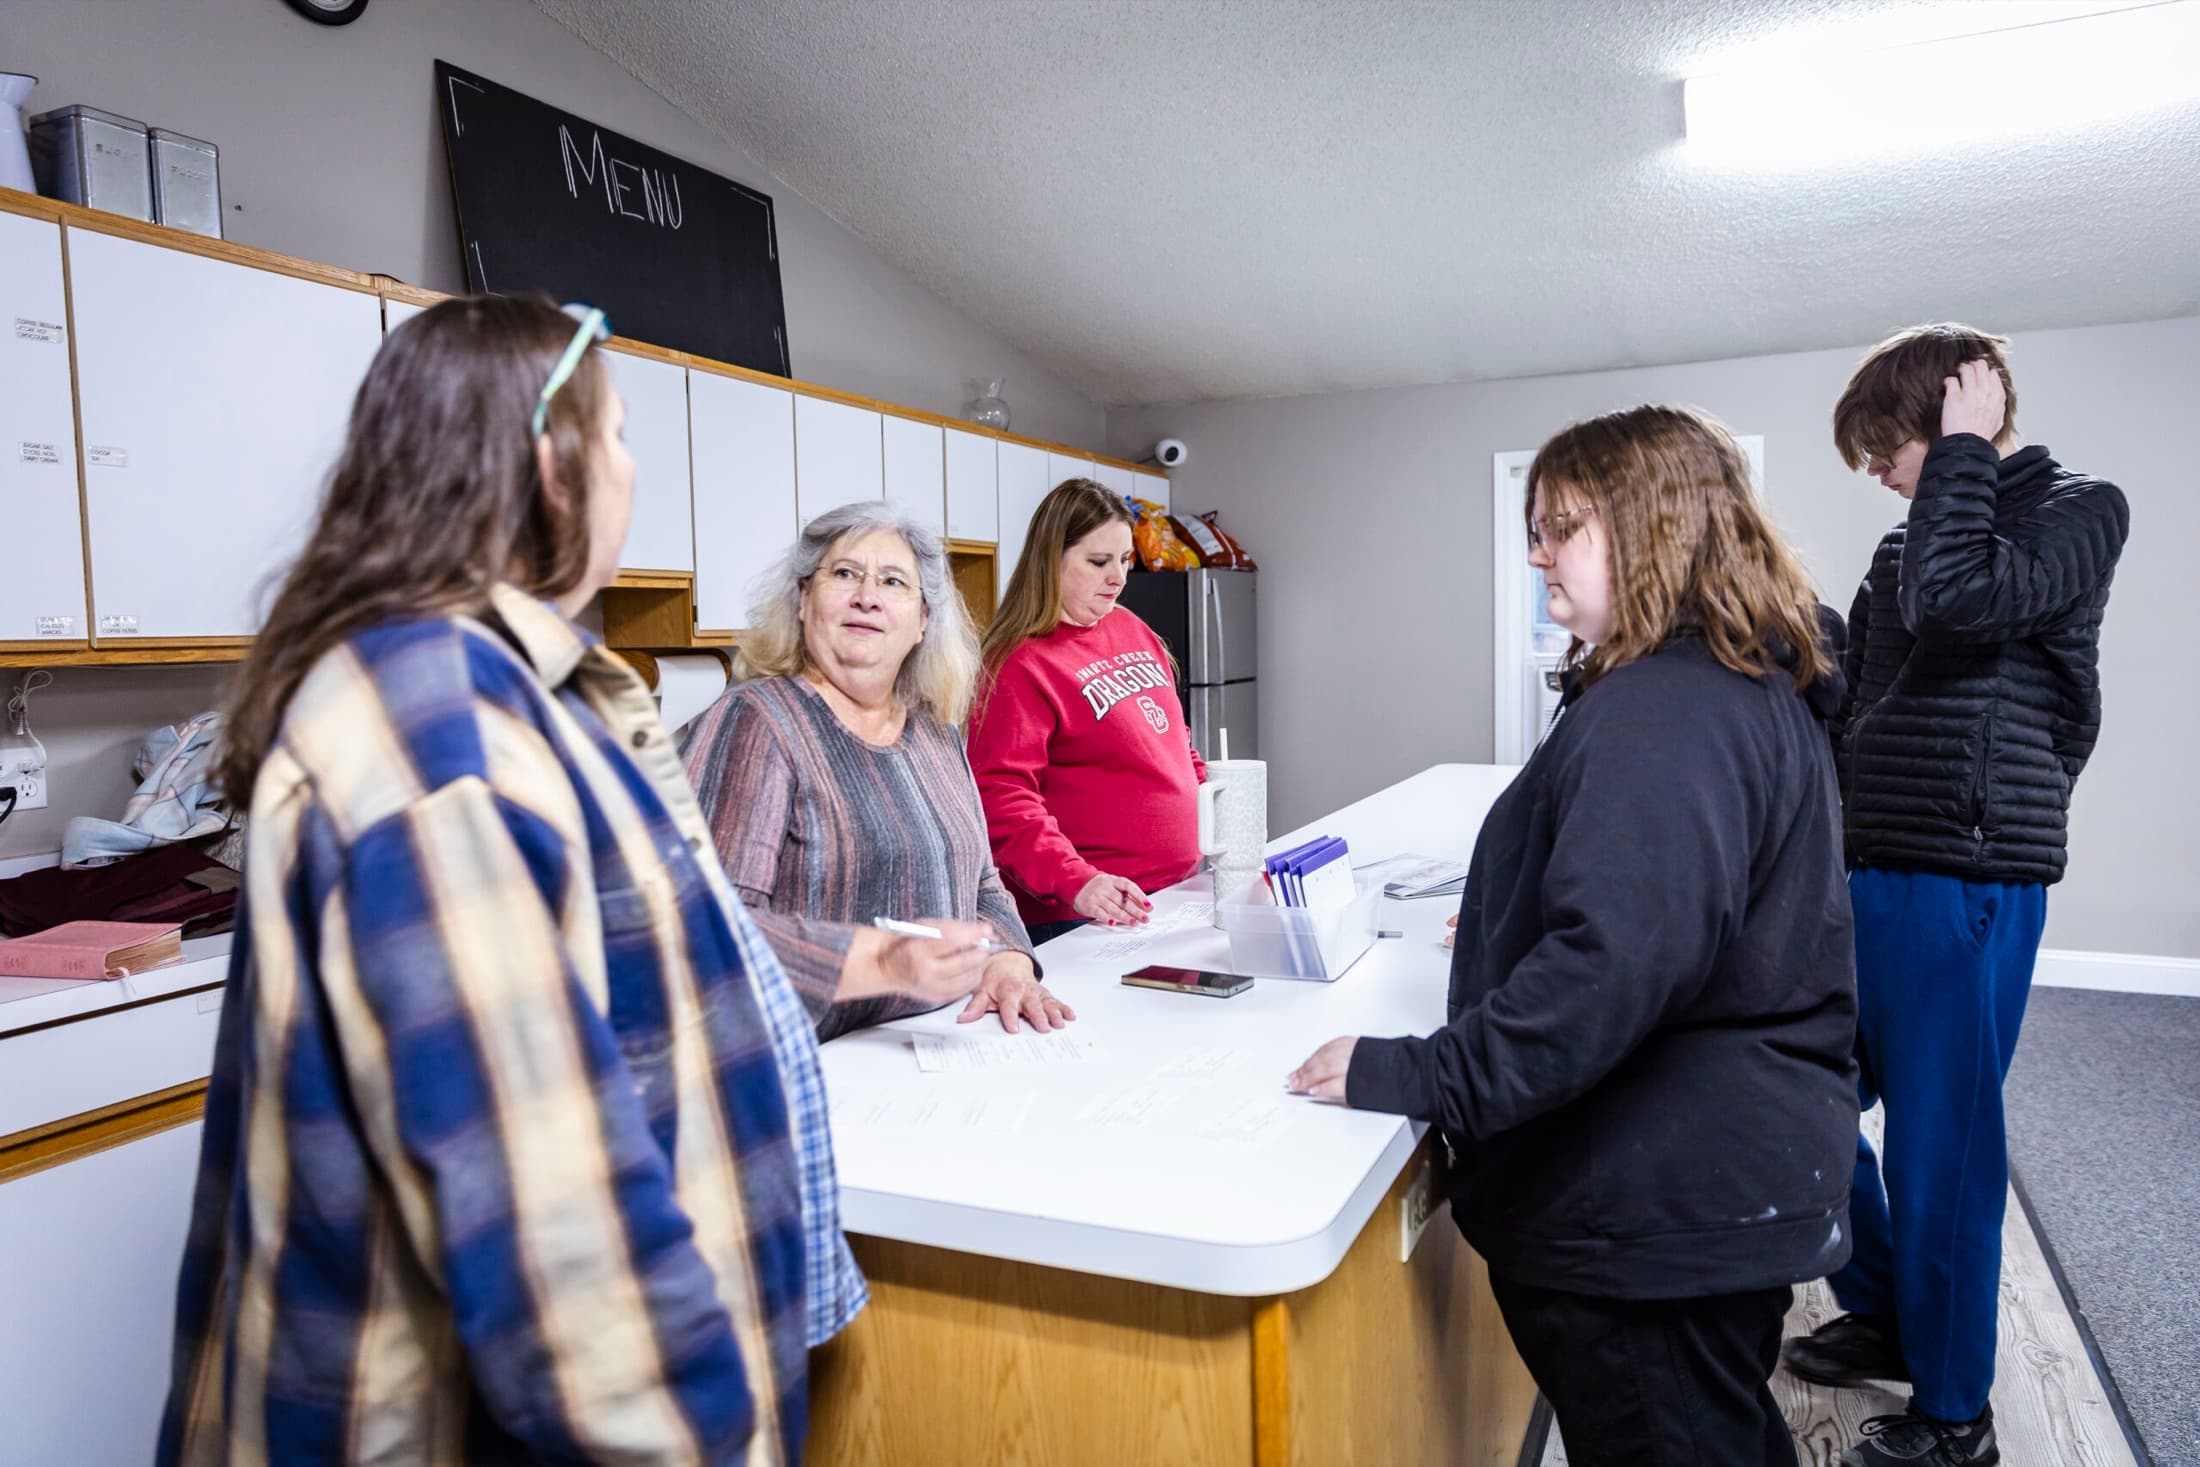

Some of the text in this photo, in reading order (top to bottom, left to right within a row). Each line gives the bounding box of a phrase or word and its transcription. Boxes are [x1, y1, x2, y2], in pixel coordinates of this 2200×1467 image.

[559, 123, 682, 229] MENU
[1075, 651, 1156, 682] SWARTZ CREEK
